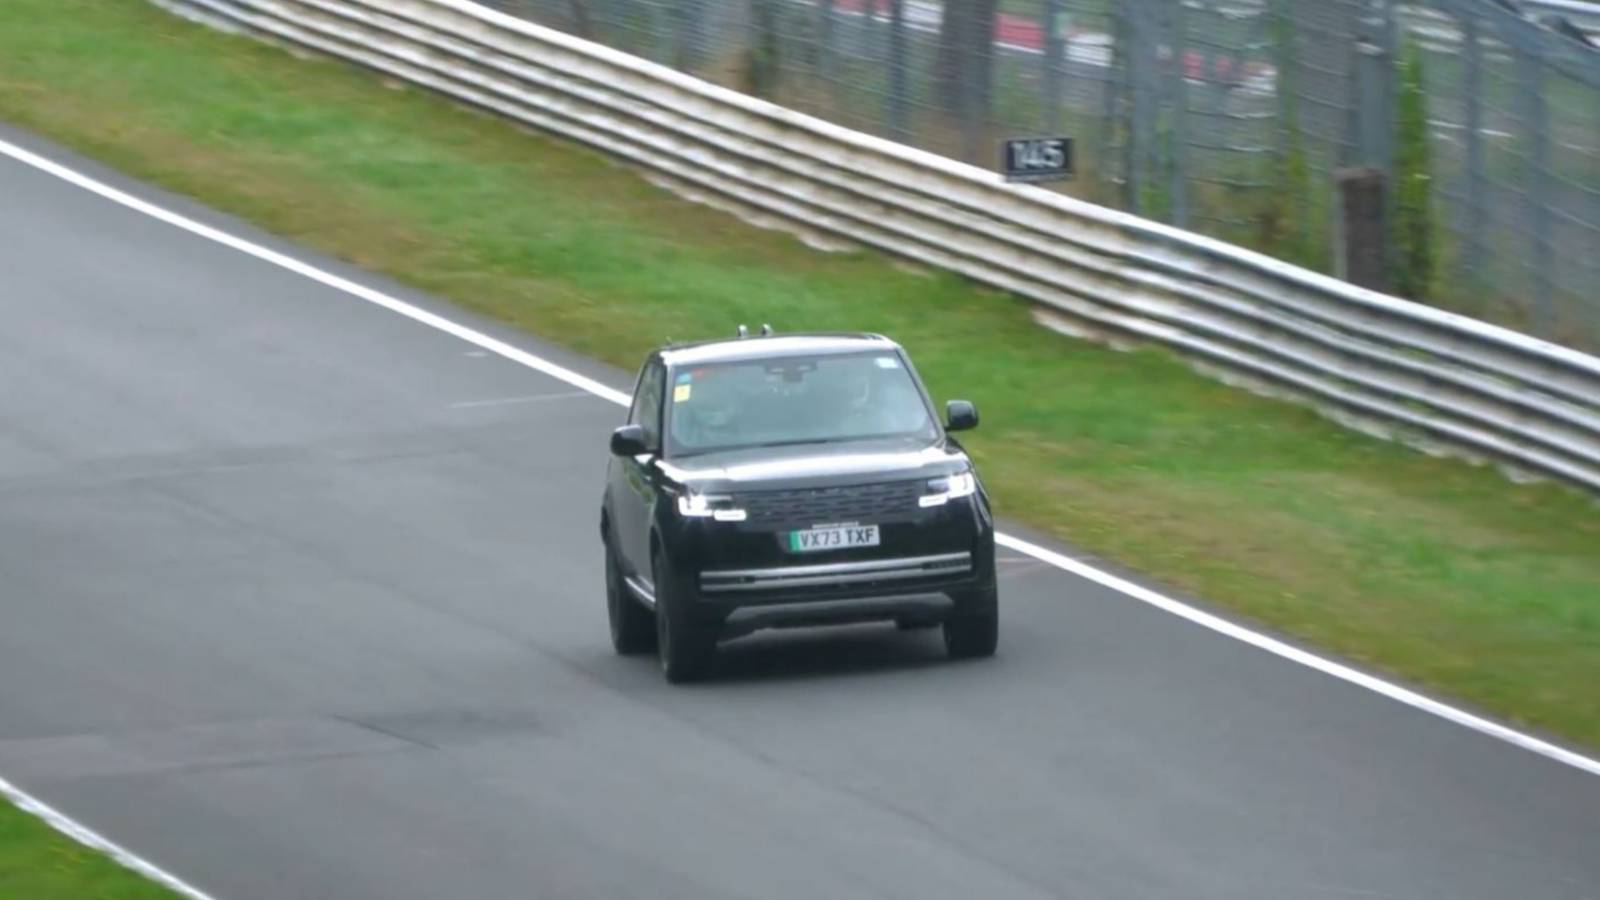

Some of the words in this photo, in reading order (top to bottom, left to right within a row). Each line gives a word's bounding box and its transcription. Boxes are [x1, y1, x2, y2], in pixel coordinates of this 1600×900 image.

[1012, 140, 1064, 168] 145
[800, 530, 840, 547] VX73
[846, 528, 874, 543] TXF
